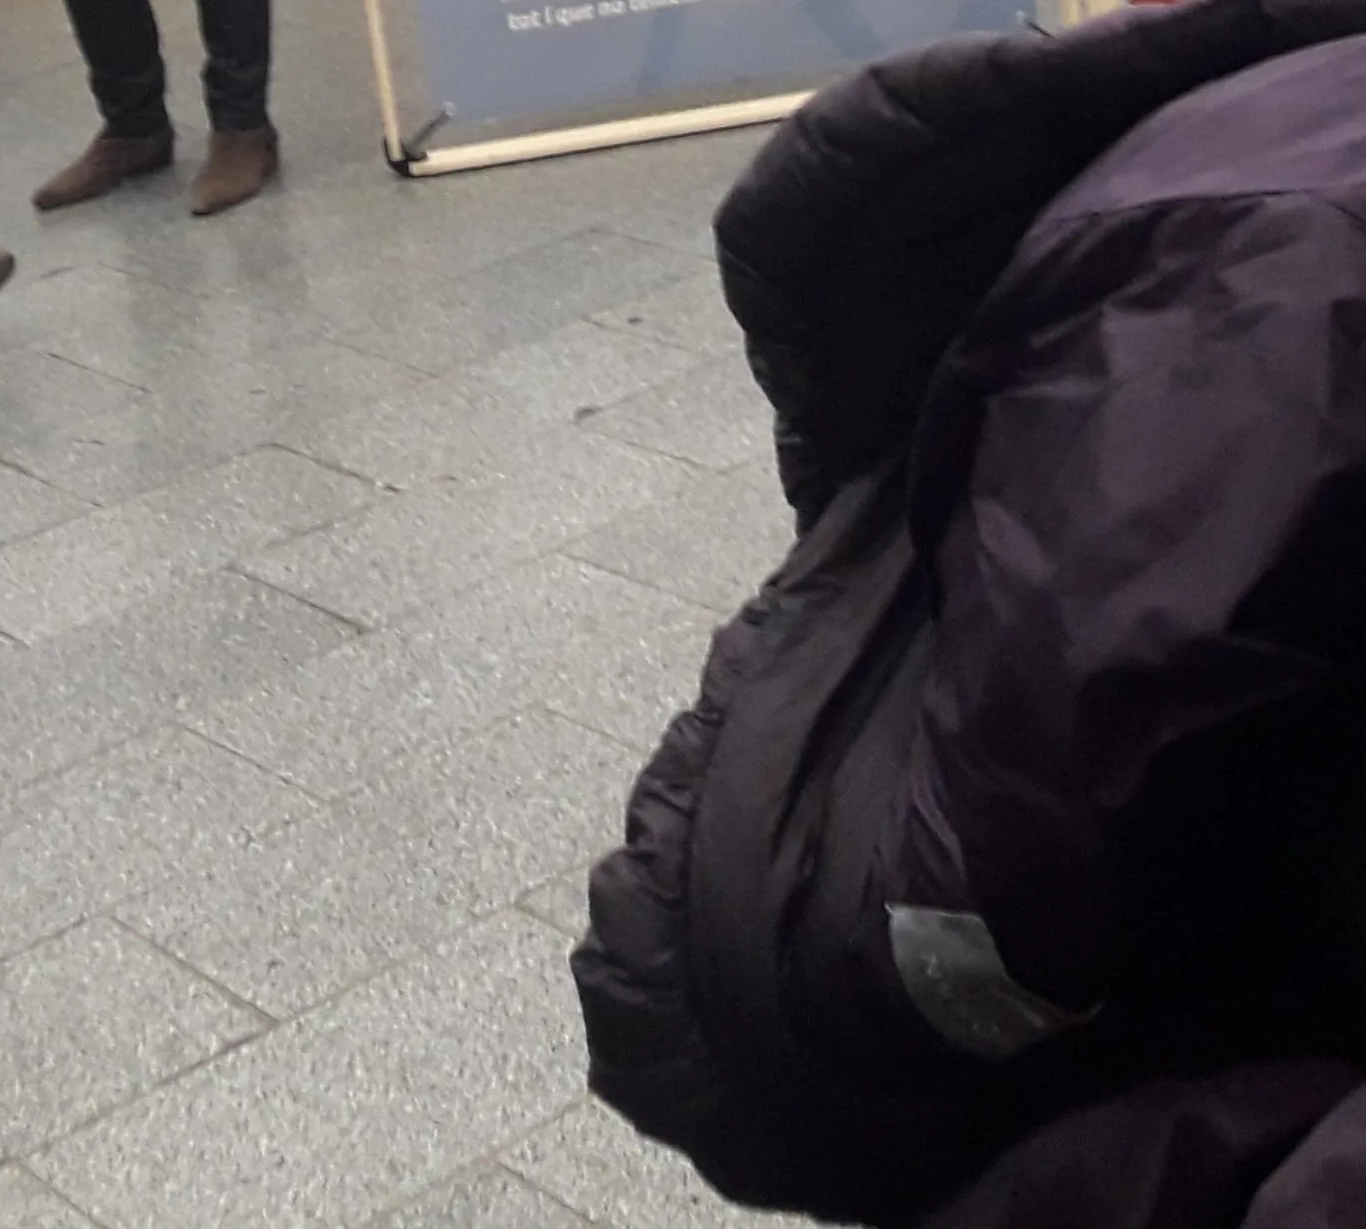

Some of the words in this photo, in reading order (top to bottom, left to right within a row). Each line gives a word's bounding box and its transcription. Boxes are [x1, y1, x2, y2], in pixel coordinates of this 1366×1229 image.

[507, 10, 541, 30] tot
[555, 3, 595, 26] que
[597, 0, 627, 16] no
